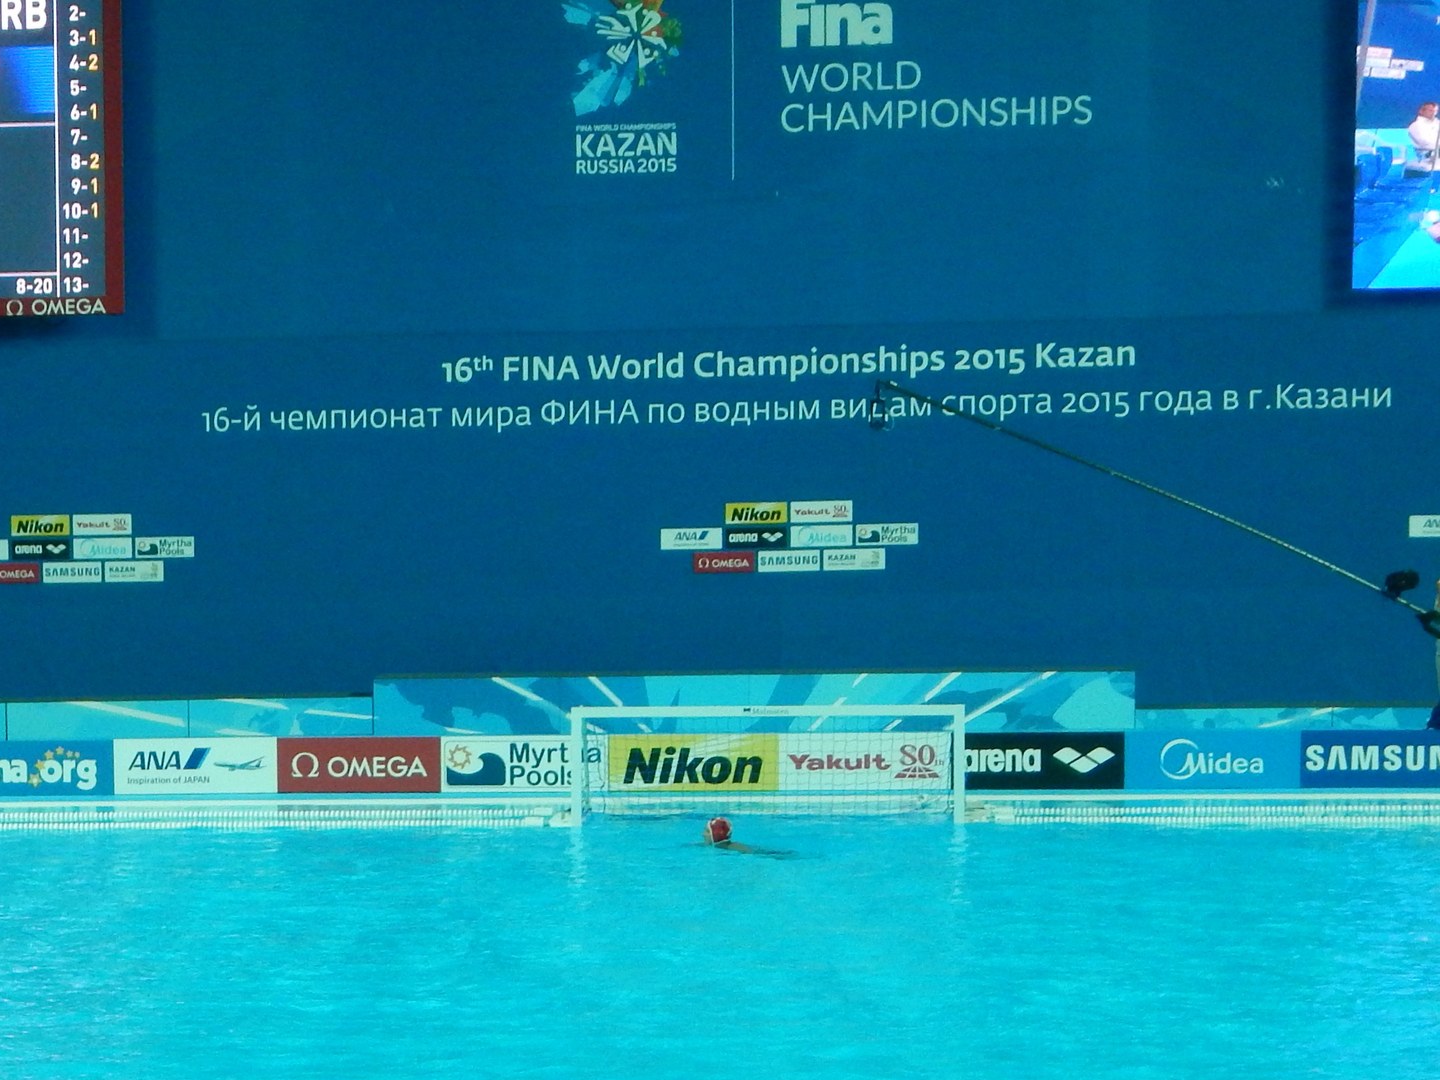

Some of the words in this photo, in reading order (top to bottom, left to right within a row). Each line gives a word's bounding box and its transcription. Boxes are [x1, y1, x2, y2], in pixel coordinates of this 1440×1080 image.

[780, 0, 893, 48] Fina
[781, 60, 922, 94] WORLD
[780, 95, 1094, 133] CHAMPIONSHIPS
[594, 123, 619, 132] WORLD
[620, 122, 677, 131] CHAMPIONSHIPS
[575, 131, 677, 158] KAZAN
[576, 159, 636, 175] RUSSIA
[637, 157, 678, 174] 2015
[16, 277, 53, 295] 8-20
[31, 297, 106, 316] OMEGA
[441, 355, 494, 383] 16th
[502, 354, 580, 382] FINA
[587, 351, 685, 381] World
[693, 344, 946, 382] Championships
[954, 347, 1026, 375] 2015
[1035, 341, 1136, 369] Kazan
[201, 404, 262, 433] 16-й
[269, 405, 443, 431] чемпионат
[451, 404, 532, 433] мира
[540, 399, 640, 426] ФИНА
[648, 402, 686, 425] по
[694, 399, 821, 427] водным
[1061, 390, 1130, 418] 2015
[1139, 389, 1213, 416] года
[1223, 389, 1240, 411] в
[731, 507, 782, 522] Nikon
[794, 508, 831, 516] Yakult
[16, 519, 65, 534] Nikon
[881, 525, 916, 537] Myrtha
[675, 531, 698, 541] ANA
[728, 532, 759, 543] arena
[808, 532, 847, 545] Midea
[881, 534, 908, 543] Pools
[14, 544, 43, 554] arena
[159, 538, 192, 550] Myrtha
[159, 547, 185, 556] Pools
[711, 558, 750, 568] OMEGA
[760, 555, 818, 566] SAMSUNG
[827, 553, 856, 561] KAZAN
[0, 568, 35, 579] OMEGA
[44, 567, 100, 577] SAMSUNG
[128, 751, 182, 771] ANA
[327, 755, 428, 779] OMEGA
[622, 746, 764, 785] Nikon
[787, 754, 892, 771] Yakult
[963, 747, 1042, 773] arena
[1175, 752, 1265, 775] Midea
[127, 776, 172, 786] Inspiration
[173, 775, 182, 784] of
[184, 775, 211, 784] JAPAN
